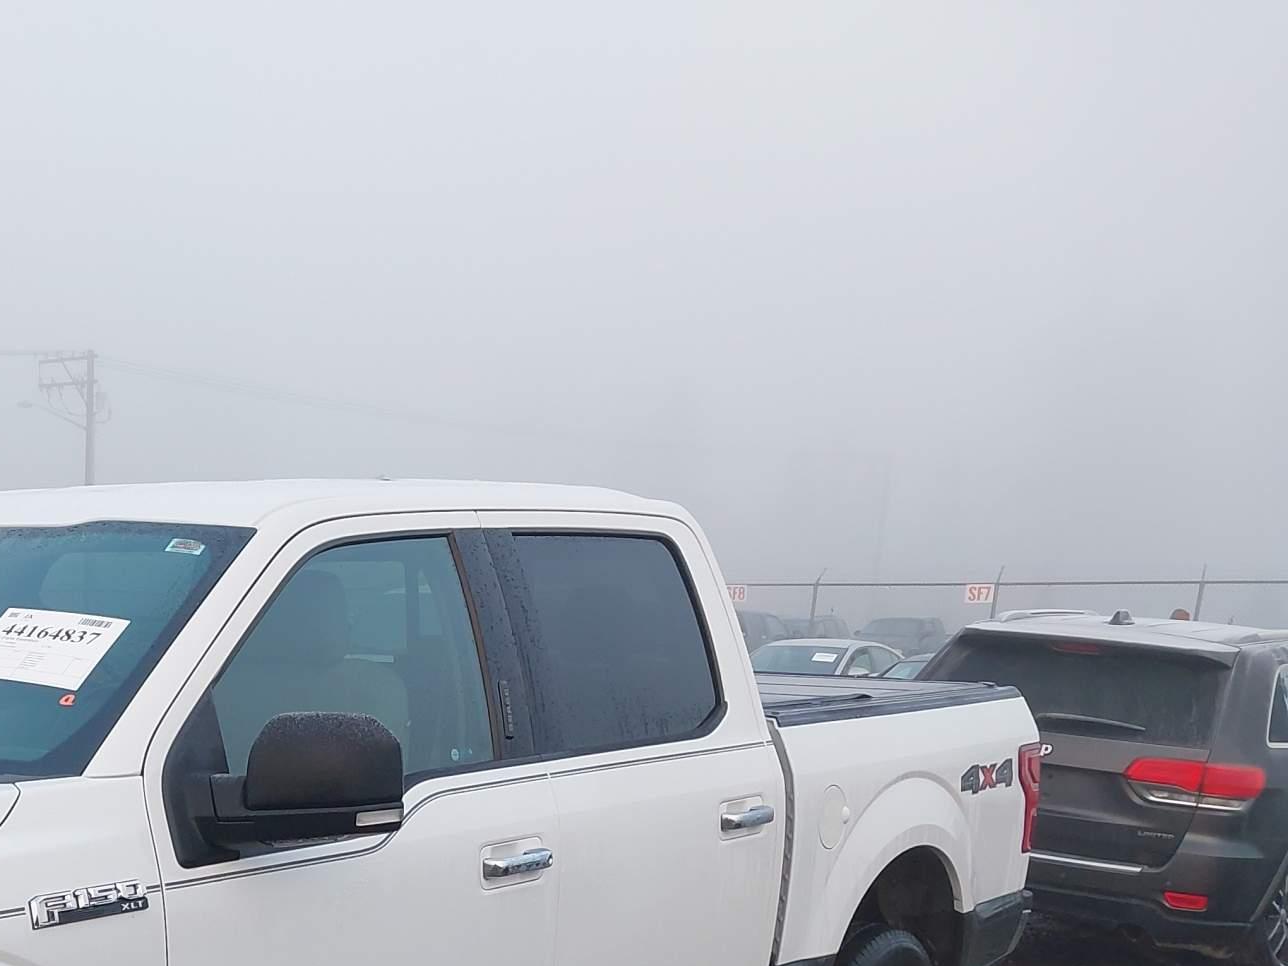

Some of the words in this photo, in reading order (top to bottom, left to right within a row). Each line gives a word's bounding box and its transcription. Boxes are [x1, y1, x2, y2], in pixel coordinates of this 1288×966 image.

[967, 586, 992, 601] SF7
[2, 623, 102, 645] 44164837
[120, 900, 145, 912] XLT
